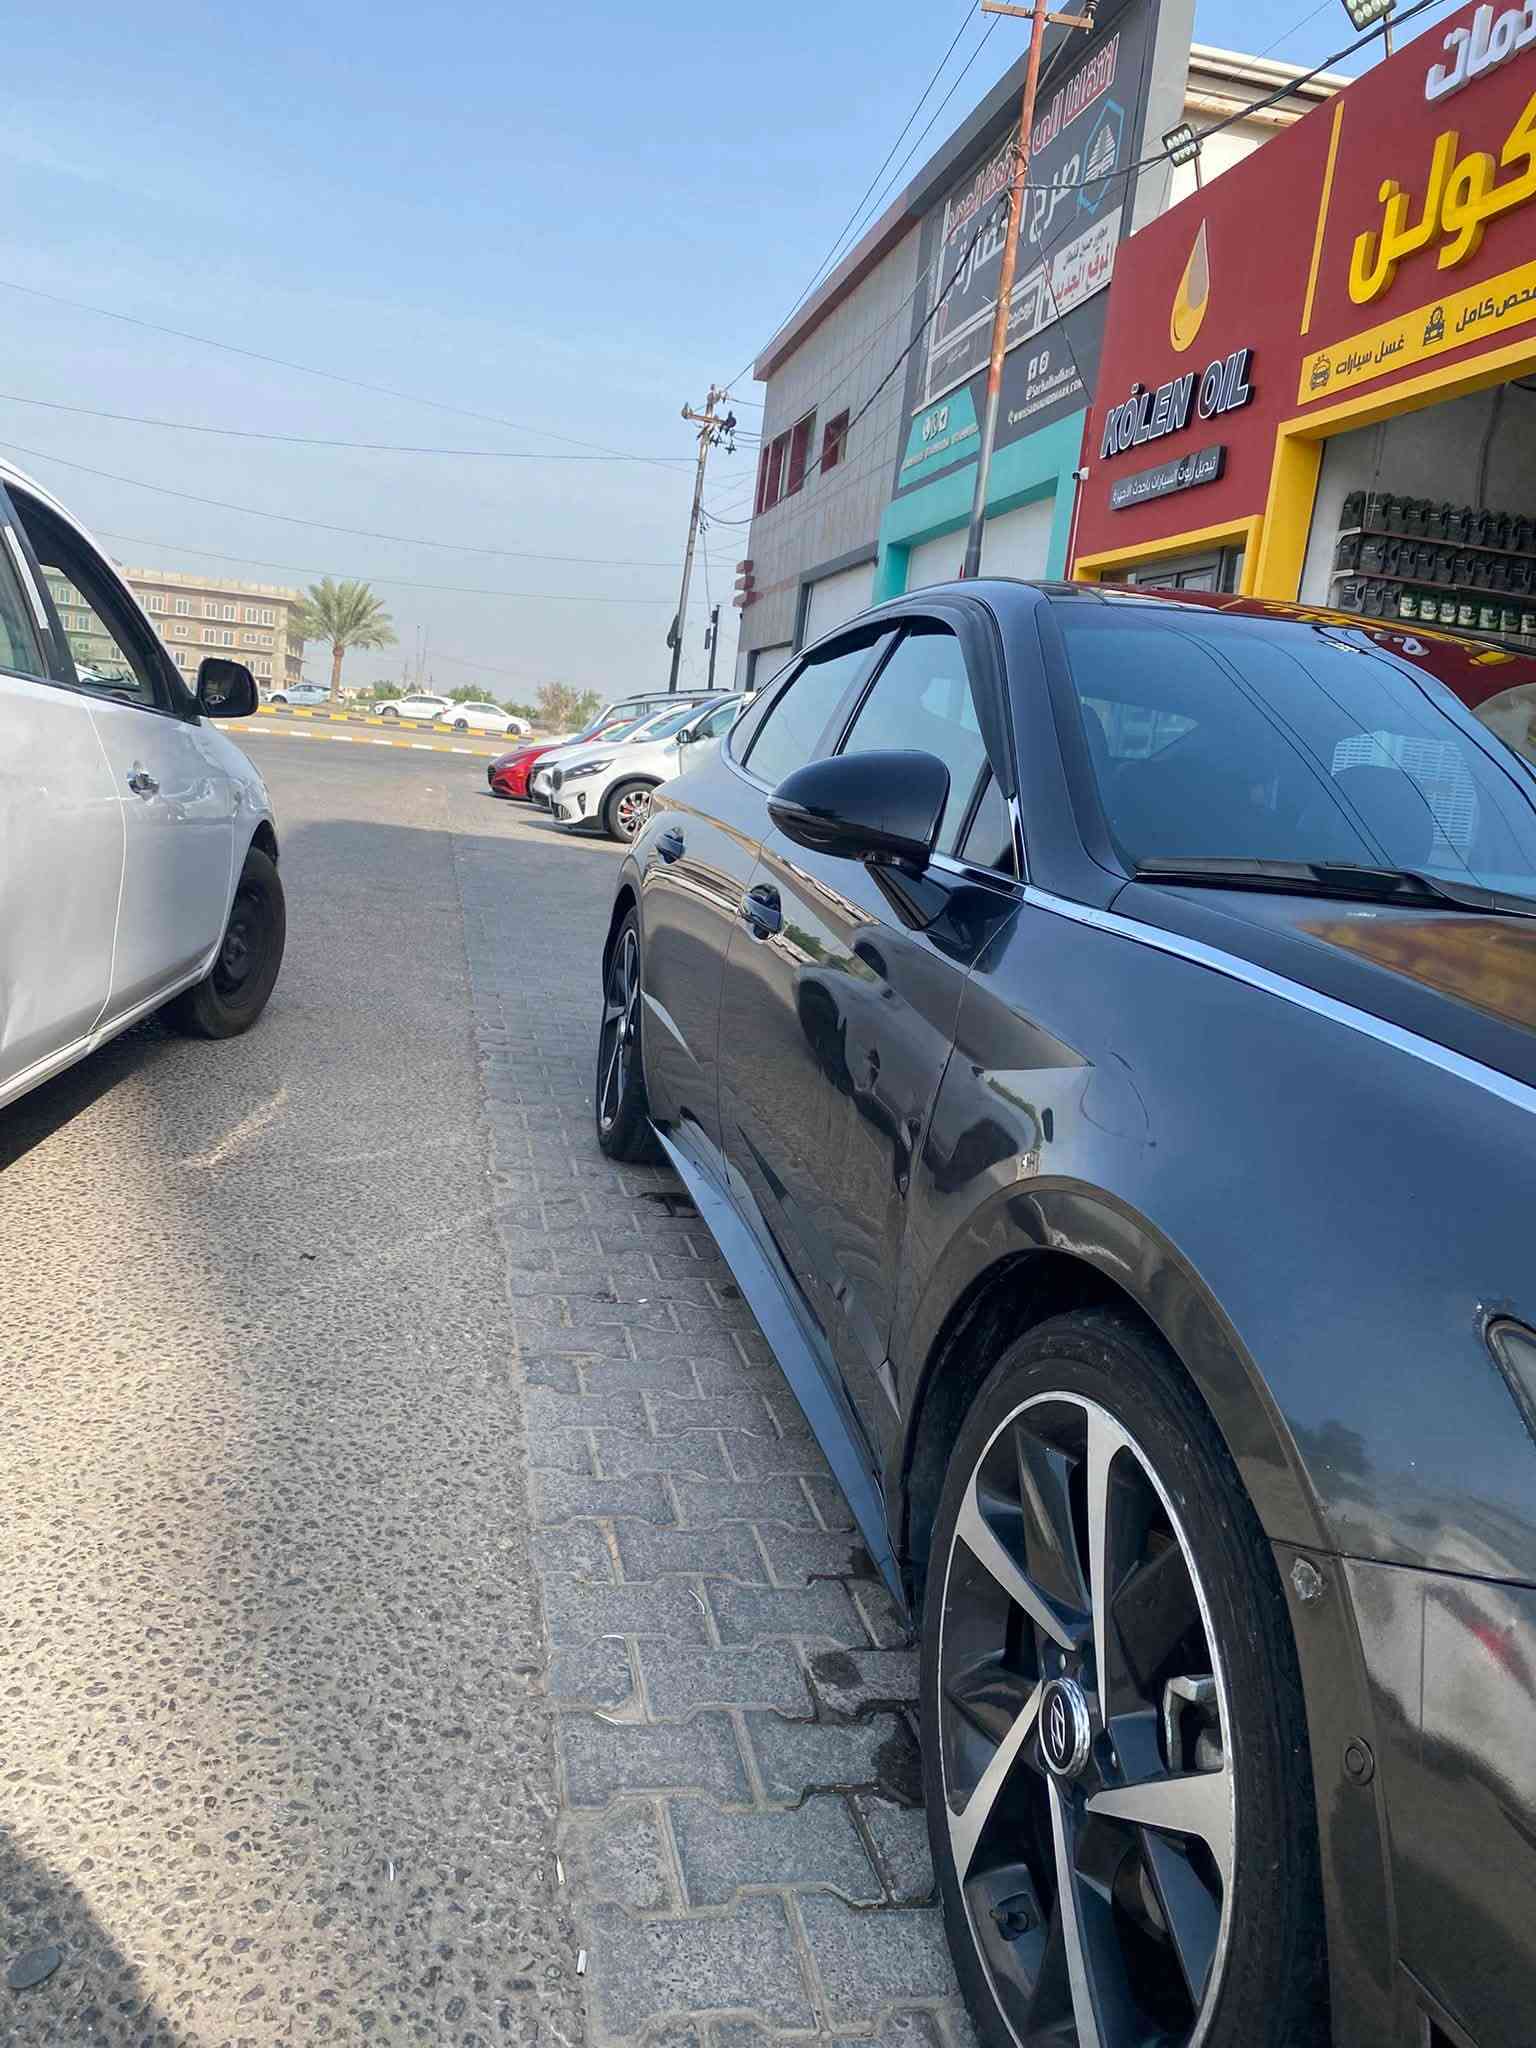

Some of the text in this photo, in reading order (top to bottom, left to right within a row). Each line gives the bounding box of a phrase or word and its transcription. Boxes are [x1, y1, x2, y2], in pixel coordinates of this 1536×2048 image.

[1455, 296, 1495, 333] كامل
[1374, 333, 1405, 364] غسل
[1197, 347, 1254, 420] OIL
